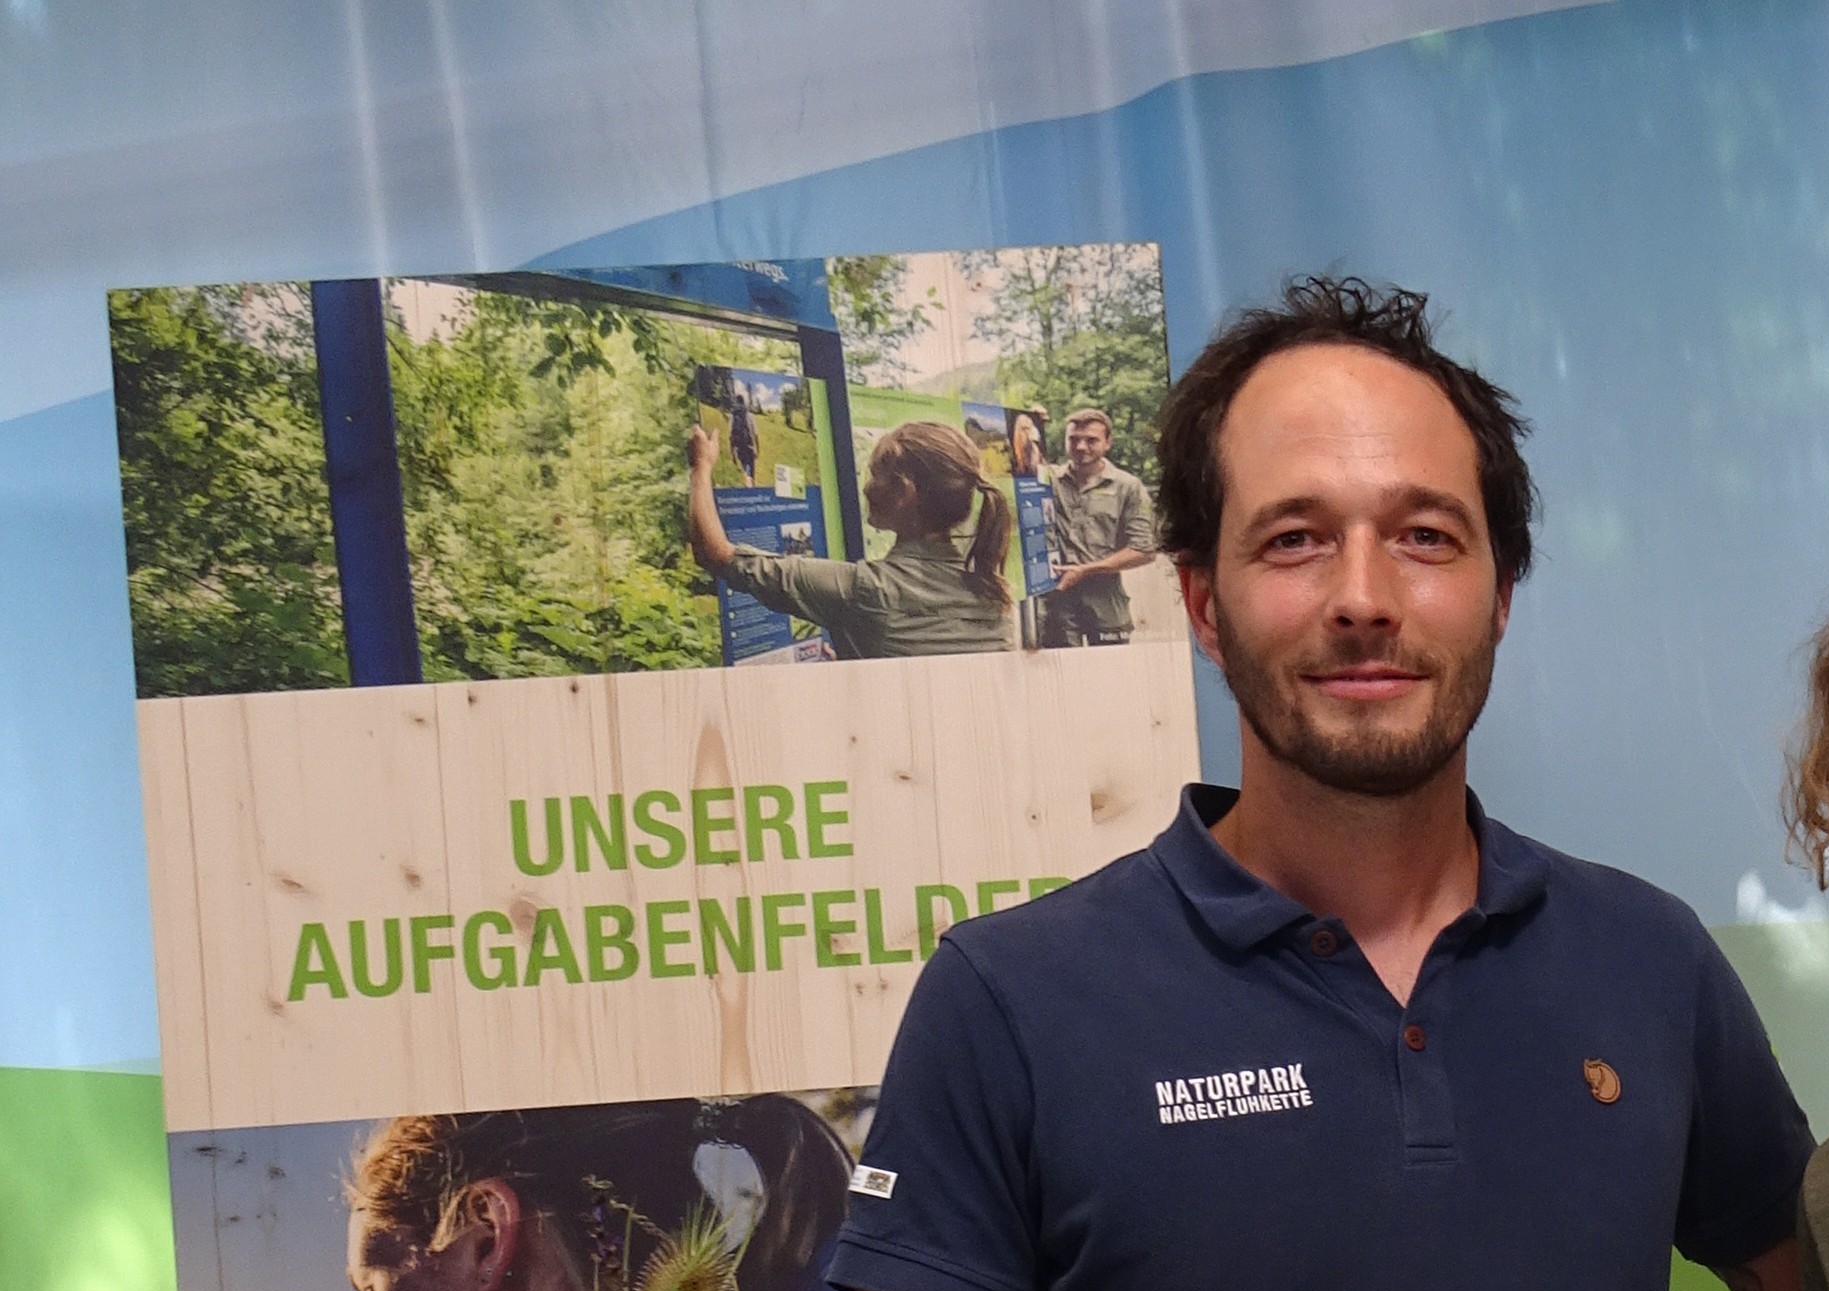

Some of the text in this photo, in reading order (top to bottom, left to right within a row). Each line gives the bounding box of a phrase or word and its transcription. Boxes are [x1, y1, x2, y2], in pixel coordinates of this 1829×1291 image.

[508, 779, 854, 878] UNSERE
[286, 876, 1075, 1003] AUFGABENFELD
[1156, 1062, 1308, 1106] NATURPARK
[1158, 1088, 1314, 1125] NAGELFLUHKETTE
